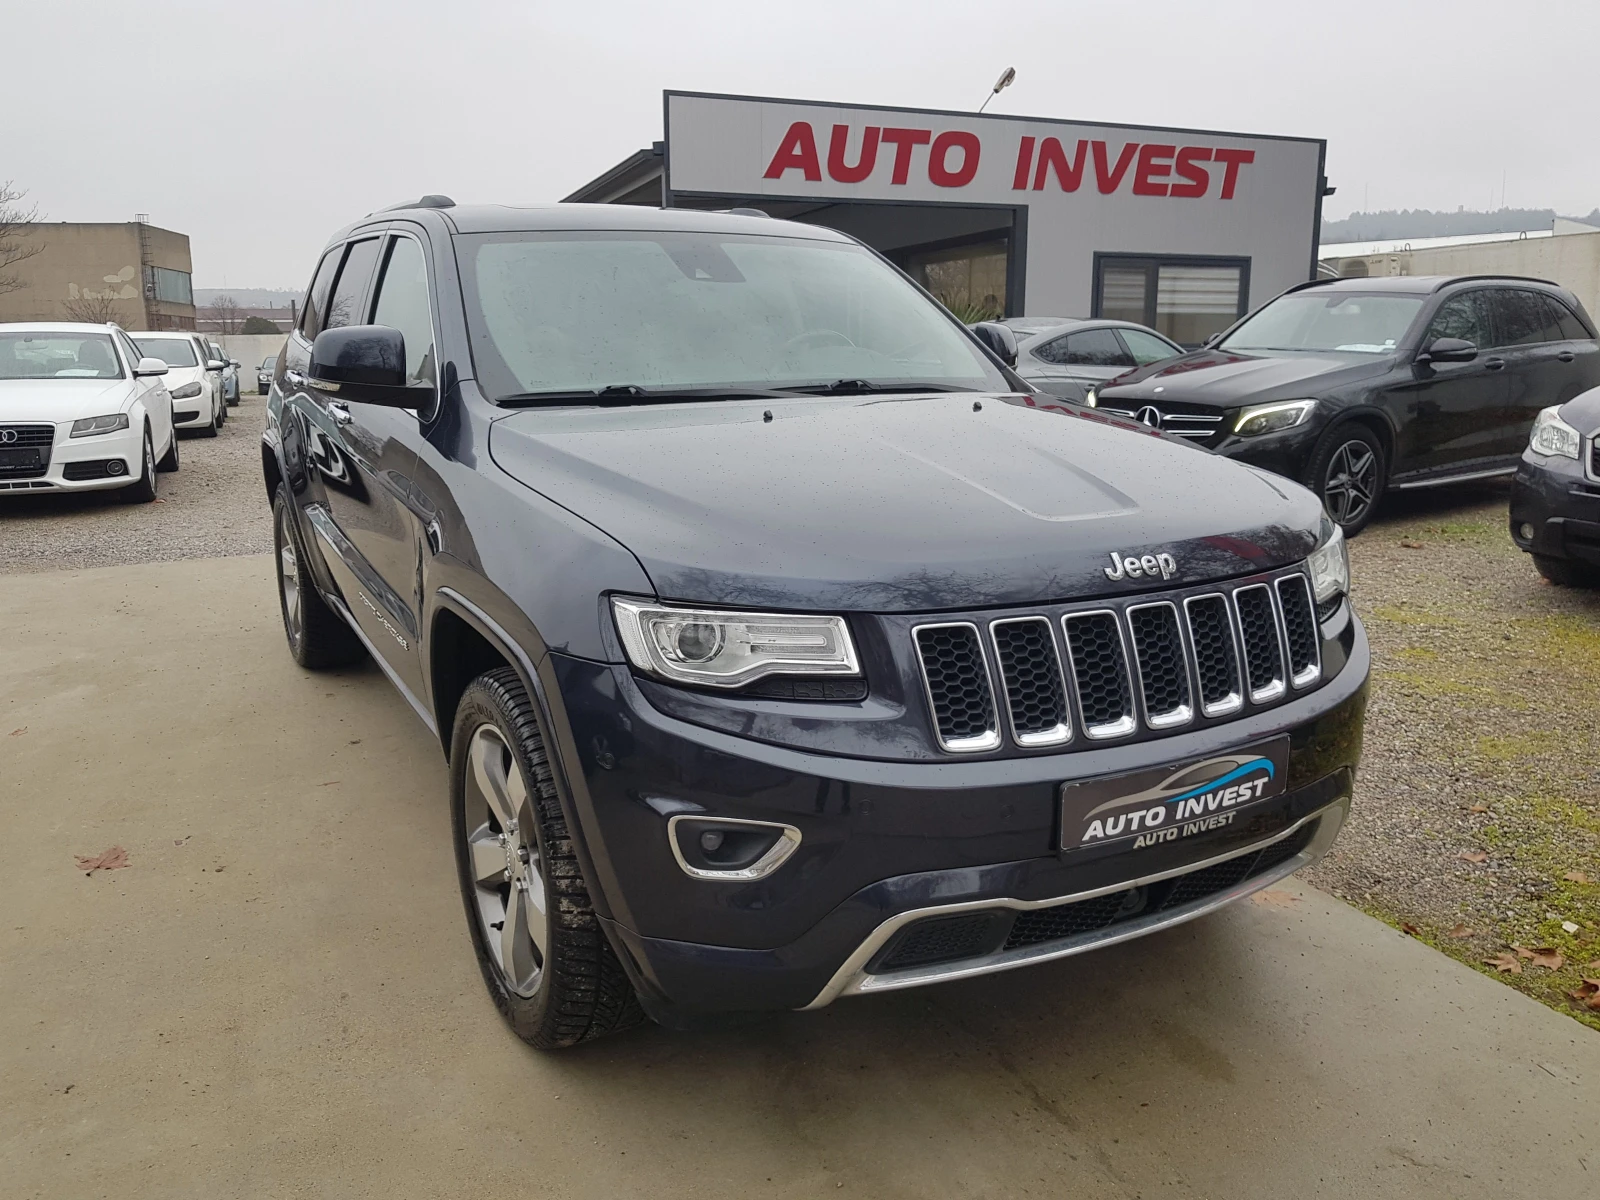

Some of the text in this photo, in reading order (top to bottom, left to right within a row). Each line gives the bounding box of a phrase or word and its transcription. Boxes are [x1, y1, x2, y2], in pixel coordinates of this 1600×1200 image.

[763, 121, 1255, 199] AUTO INVEST
[1103, 551, 1177, 581] Jeep
[1081, 776, 1270, 842] AUTO INVEST
[1132, 810, 1237, 849] AUTO INVEST
